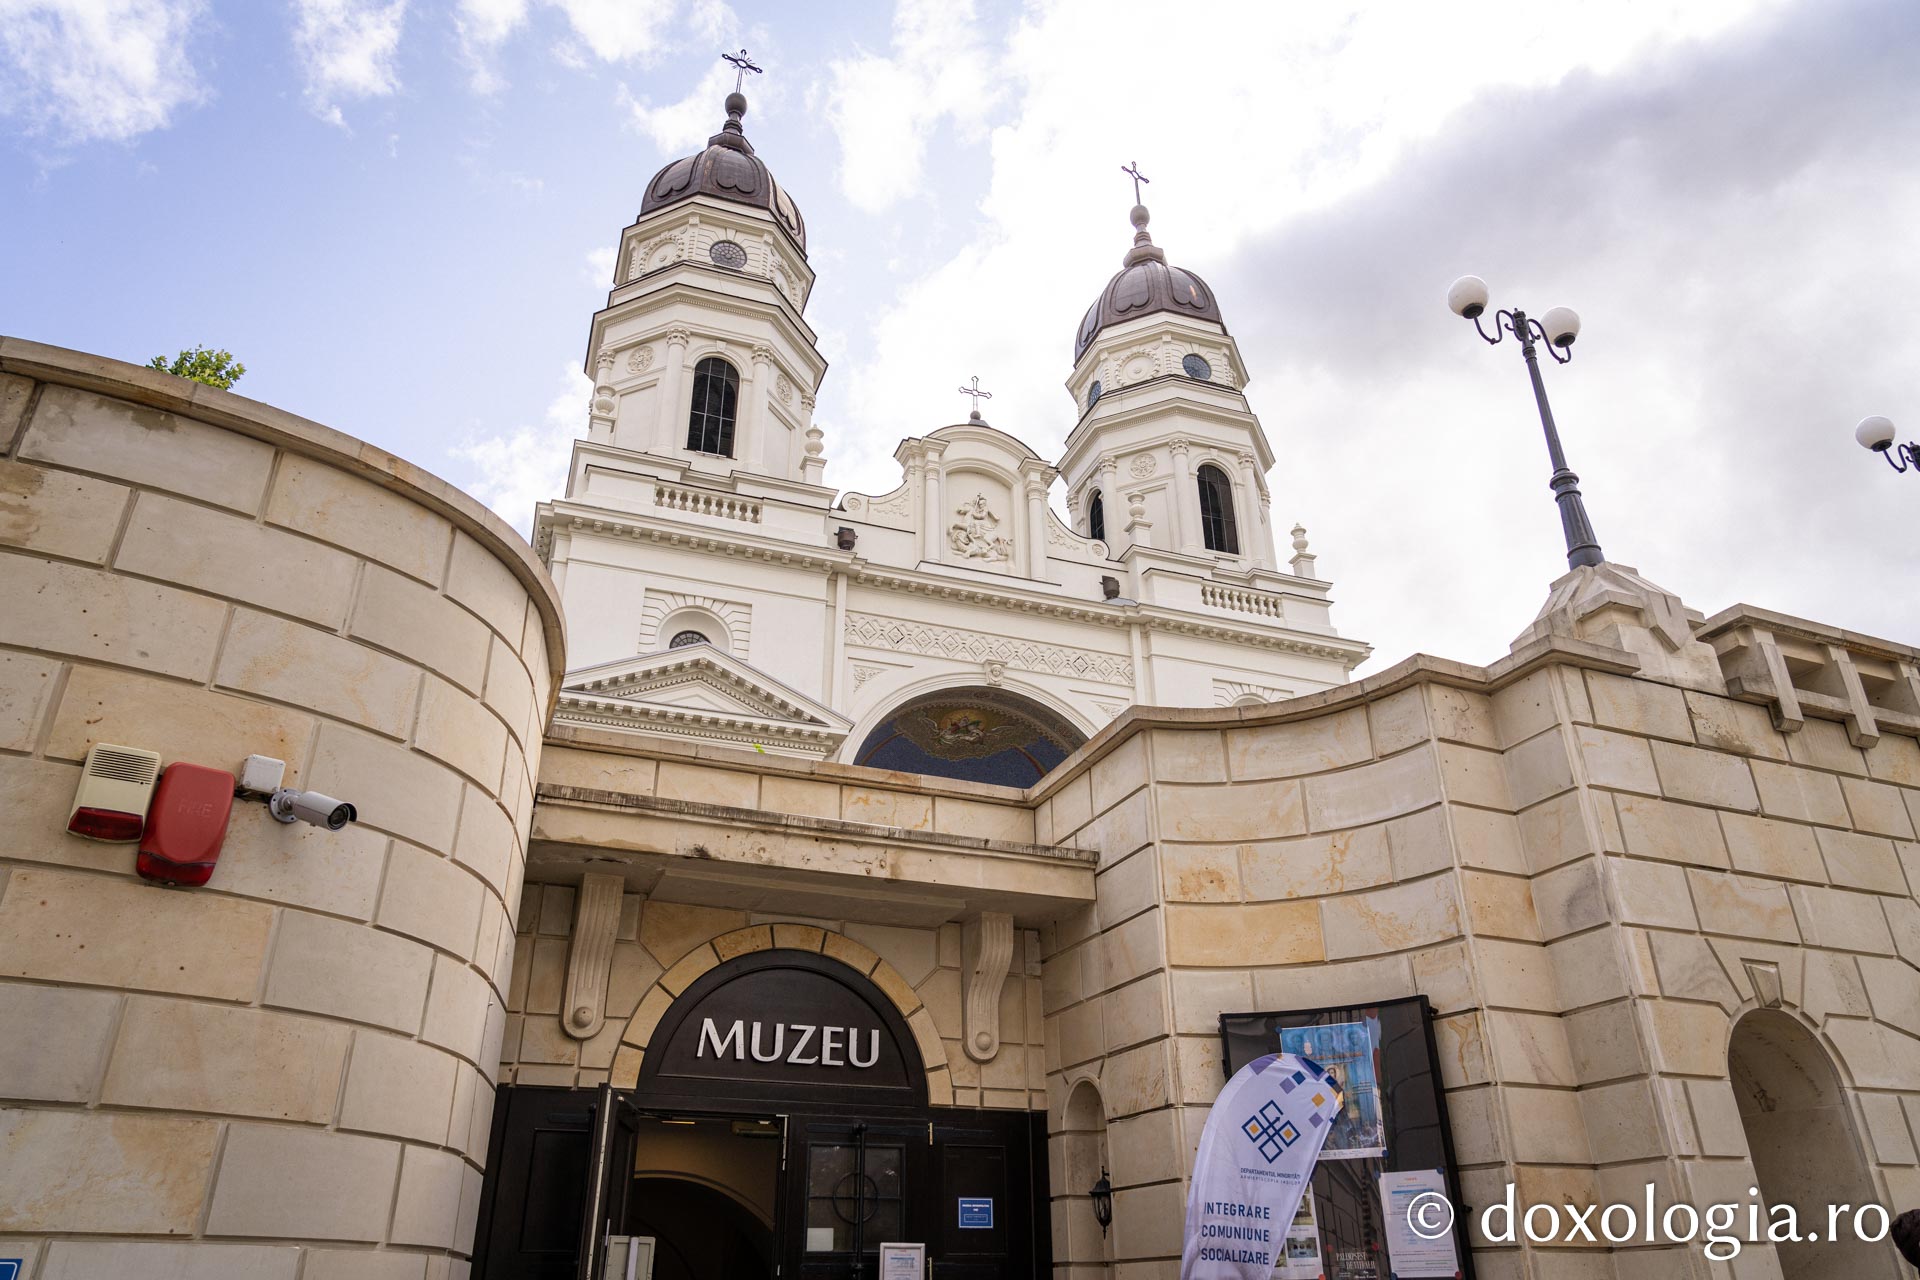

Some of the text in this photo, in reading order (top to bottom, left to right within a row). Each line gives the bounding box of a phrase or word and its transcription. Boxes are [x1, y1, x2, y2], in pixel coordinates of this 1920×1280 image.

[696, 1017, 881, 1068] MUZEU
[1203, 1201, 1270, 1220] INTEGRARE
[1201, 1224, 1270, 1242] COMUNIUNE
[1200, 1247, 1270, 1265] SOCIALIZARE
